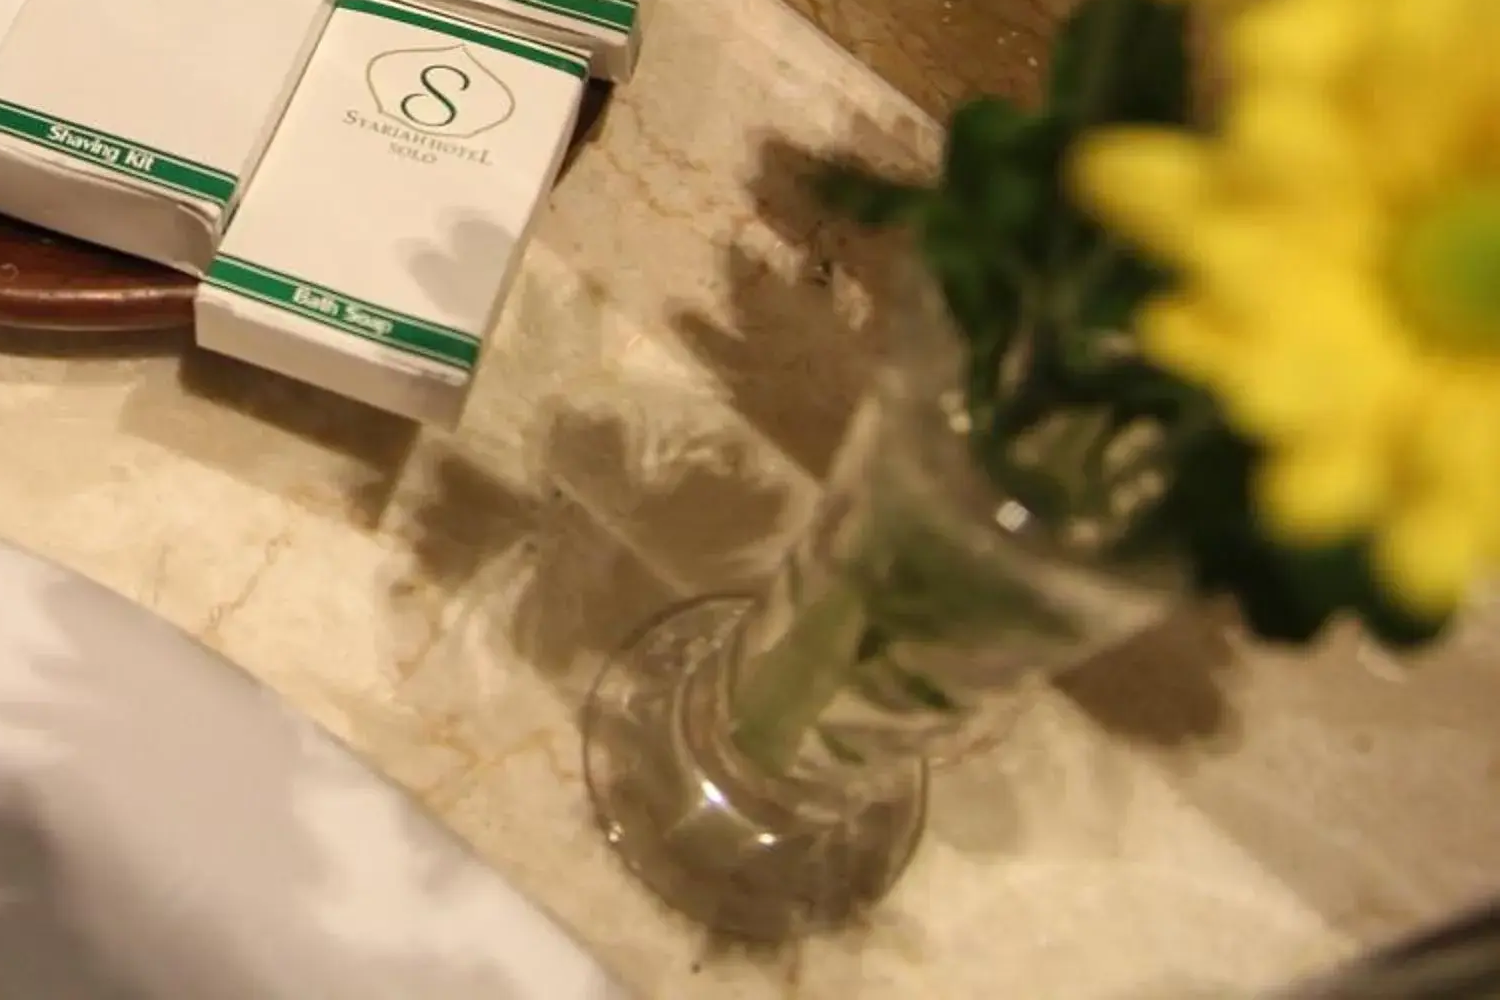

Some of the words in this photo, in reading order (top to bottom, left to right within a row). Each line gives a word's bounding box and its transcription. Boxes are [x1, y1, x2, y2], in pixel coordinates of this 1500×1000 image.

[47, 124, 121, 164] Shaving
[124, 147, 156, 171] Kit
[389, 141, 438, 164] SOLO
[292, 285, 339, 316] Bath
[343, 303, 394, 335] Soap
